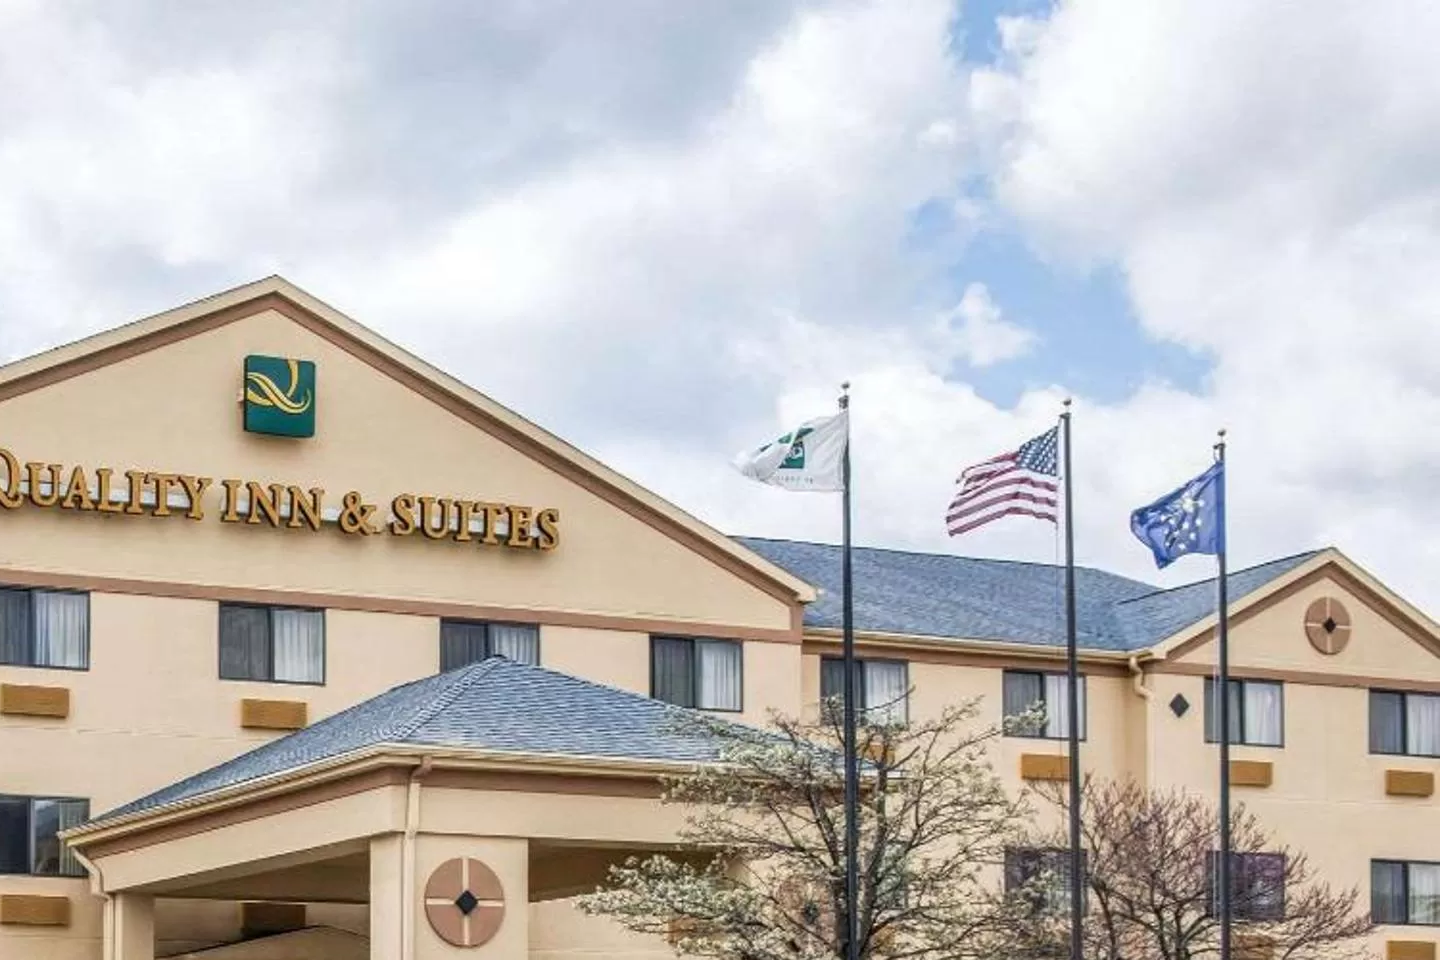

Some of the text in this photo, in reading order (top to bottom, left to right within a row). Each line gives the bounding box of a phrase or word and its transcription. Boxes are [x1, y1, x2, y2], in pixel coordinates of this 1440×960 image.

[220, 478, 325, 532] INN
[339, 490, 381, 536] &
[389, 493, 560, 550] SUITES
